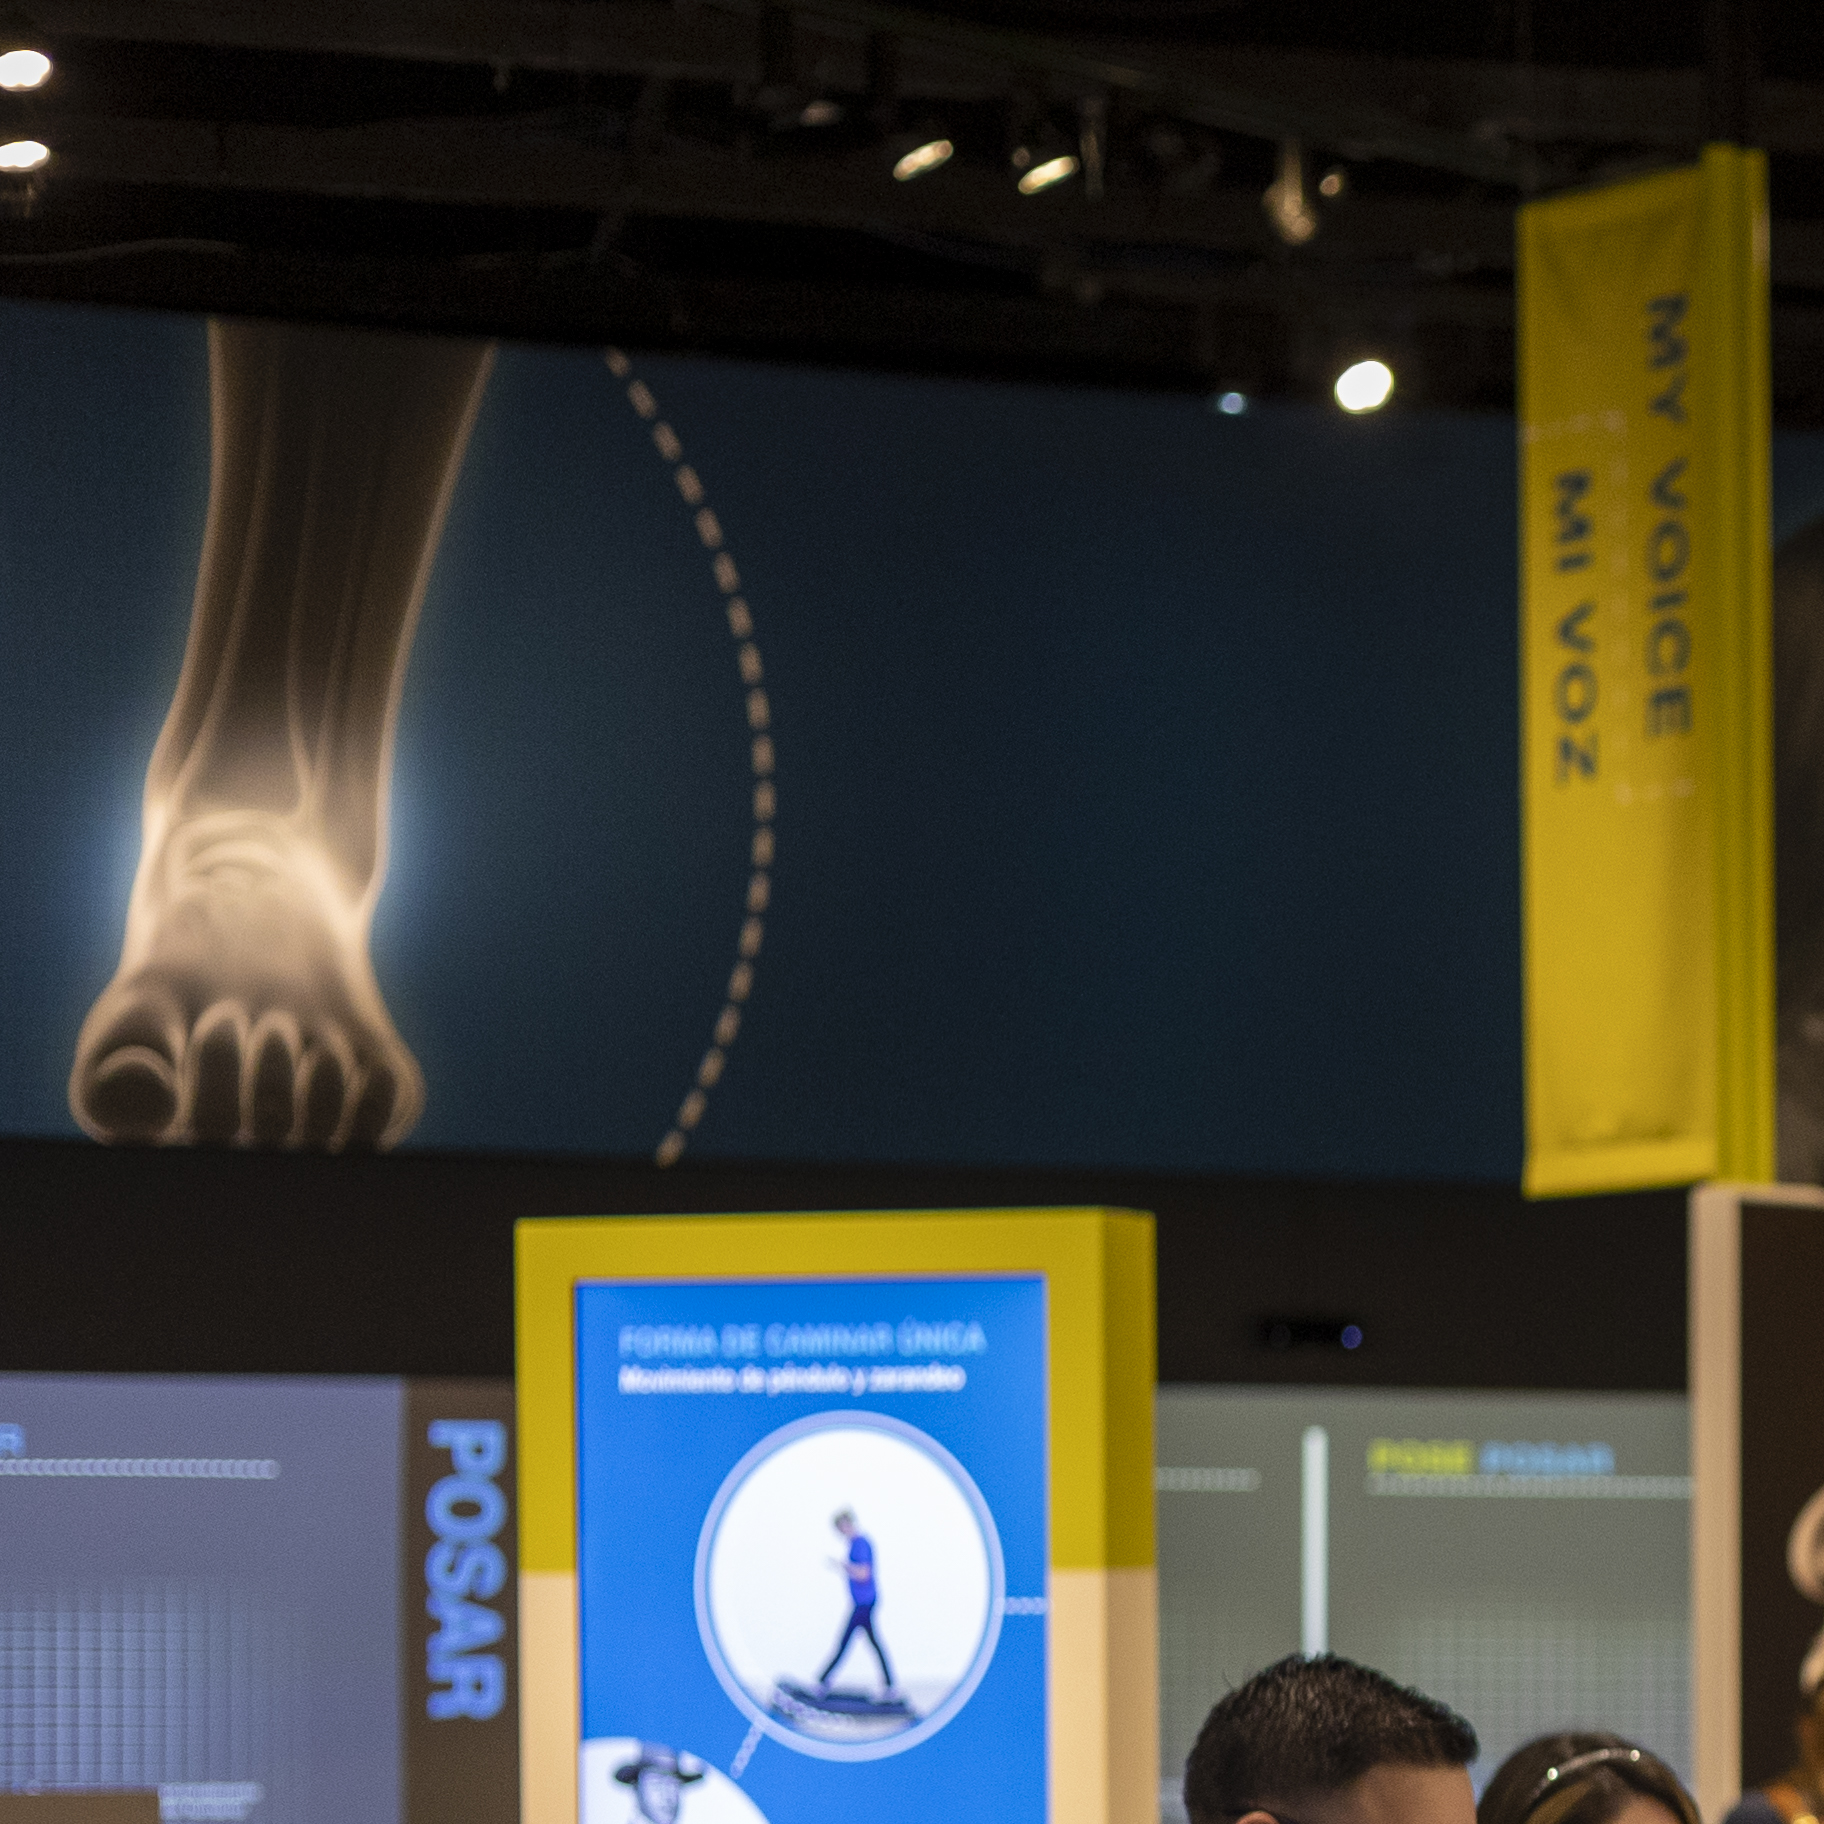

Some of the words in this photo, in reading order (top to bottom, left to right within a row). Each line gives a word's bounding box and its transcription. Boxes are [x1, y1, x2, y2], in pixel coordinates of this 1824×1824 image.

[1645, 291, 1691, 425] MY
[1553, 468, 1596, 575] MI
[1645, 457, 1693, 739] VOICE
[1552, 601, 1600, 788] VOZ
[721, 1323, 762, 1358] DE
[425, 1419, 507, 1720] POSAR
